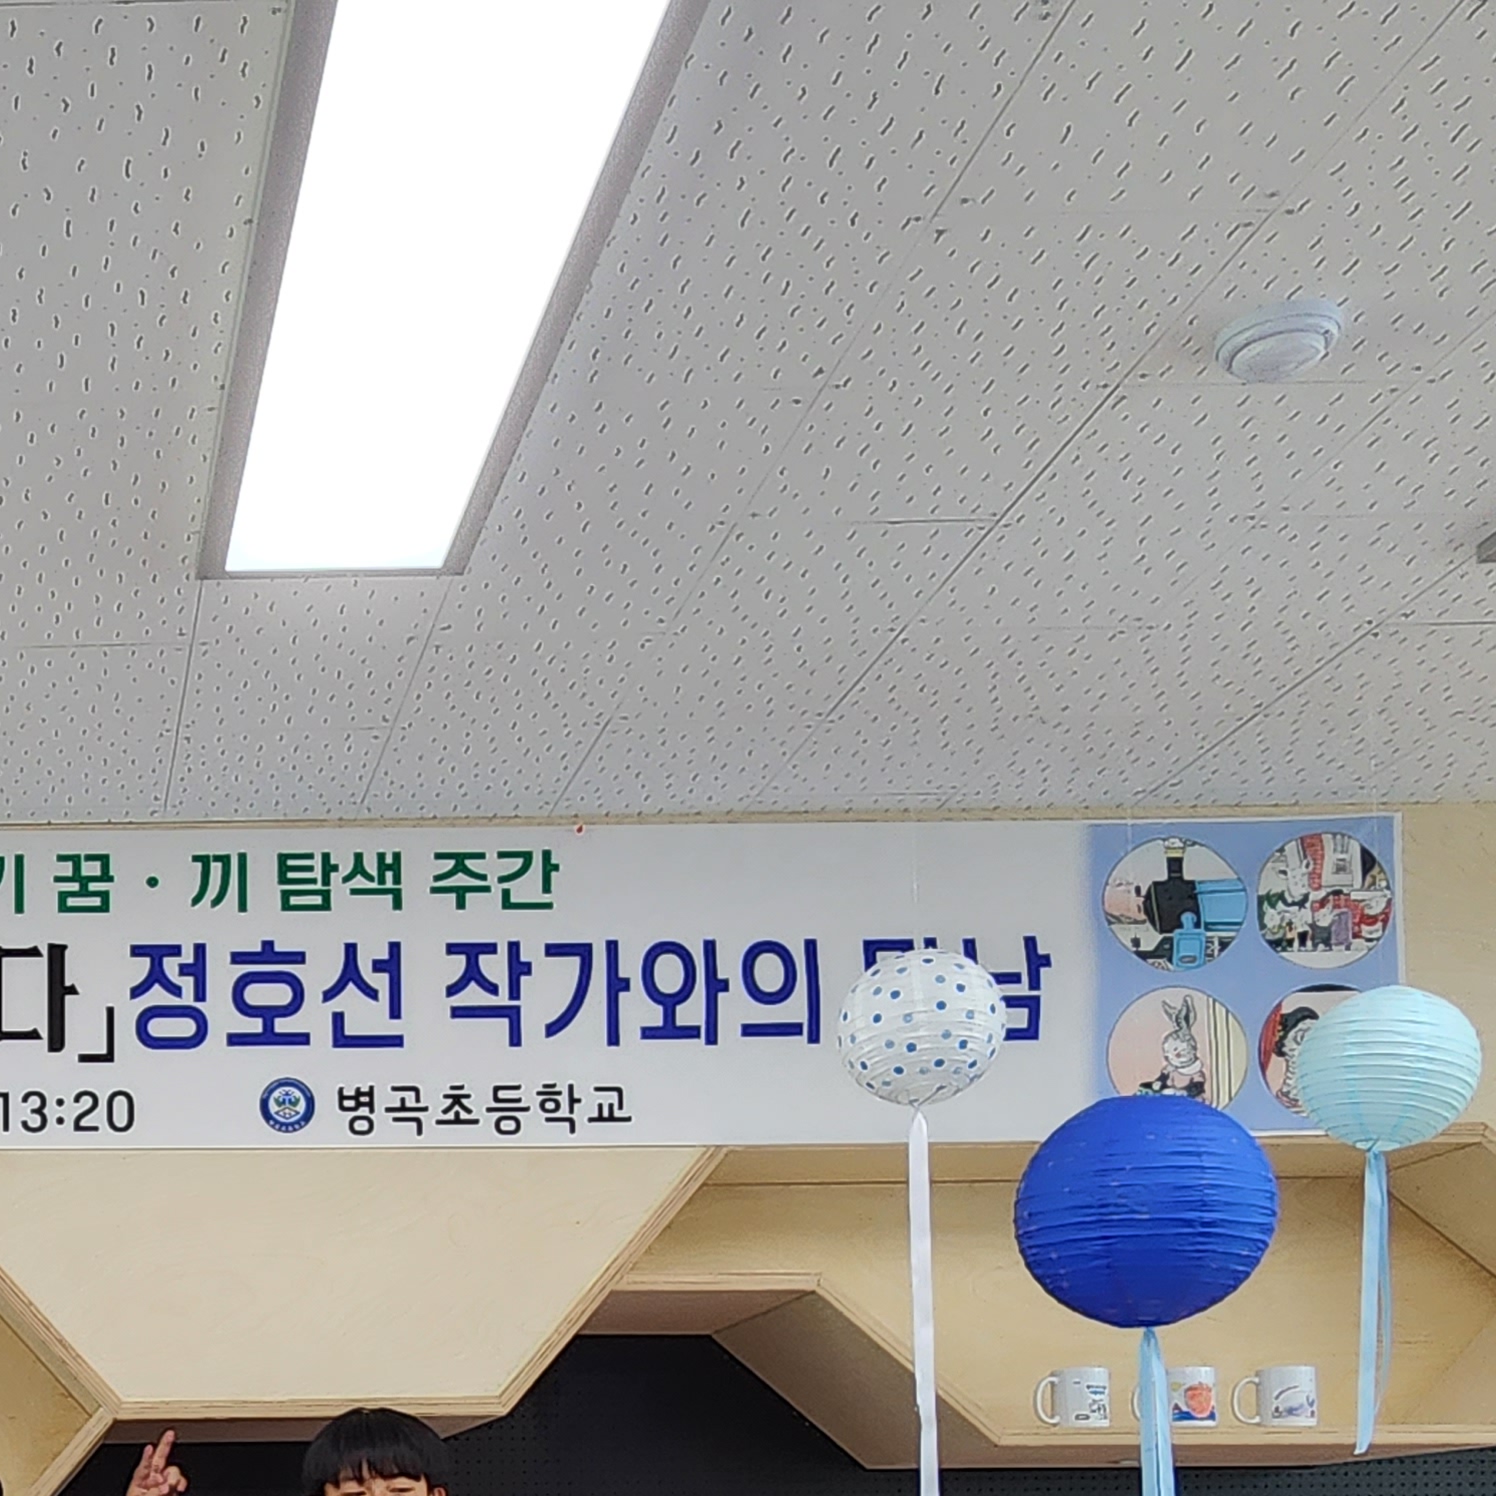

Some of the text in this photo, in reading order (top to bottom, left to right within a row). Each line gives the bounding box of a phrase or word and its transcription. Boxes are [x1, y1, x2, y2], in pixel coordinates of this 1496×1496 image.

[52, 852, 116, 914] 꿈
[190, 851, 249, 913] 끼
[276, 850, 404, 912] 탐색
[429, 848, 561, 911] 주간
[445, 938, 822, 1048] 작가와의
[860, 935, 1053, 1043] 남
[337, 1083, 633, 1136] 병곡초등학교
